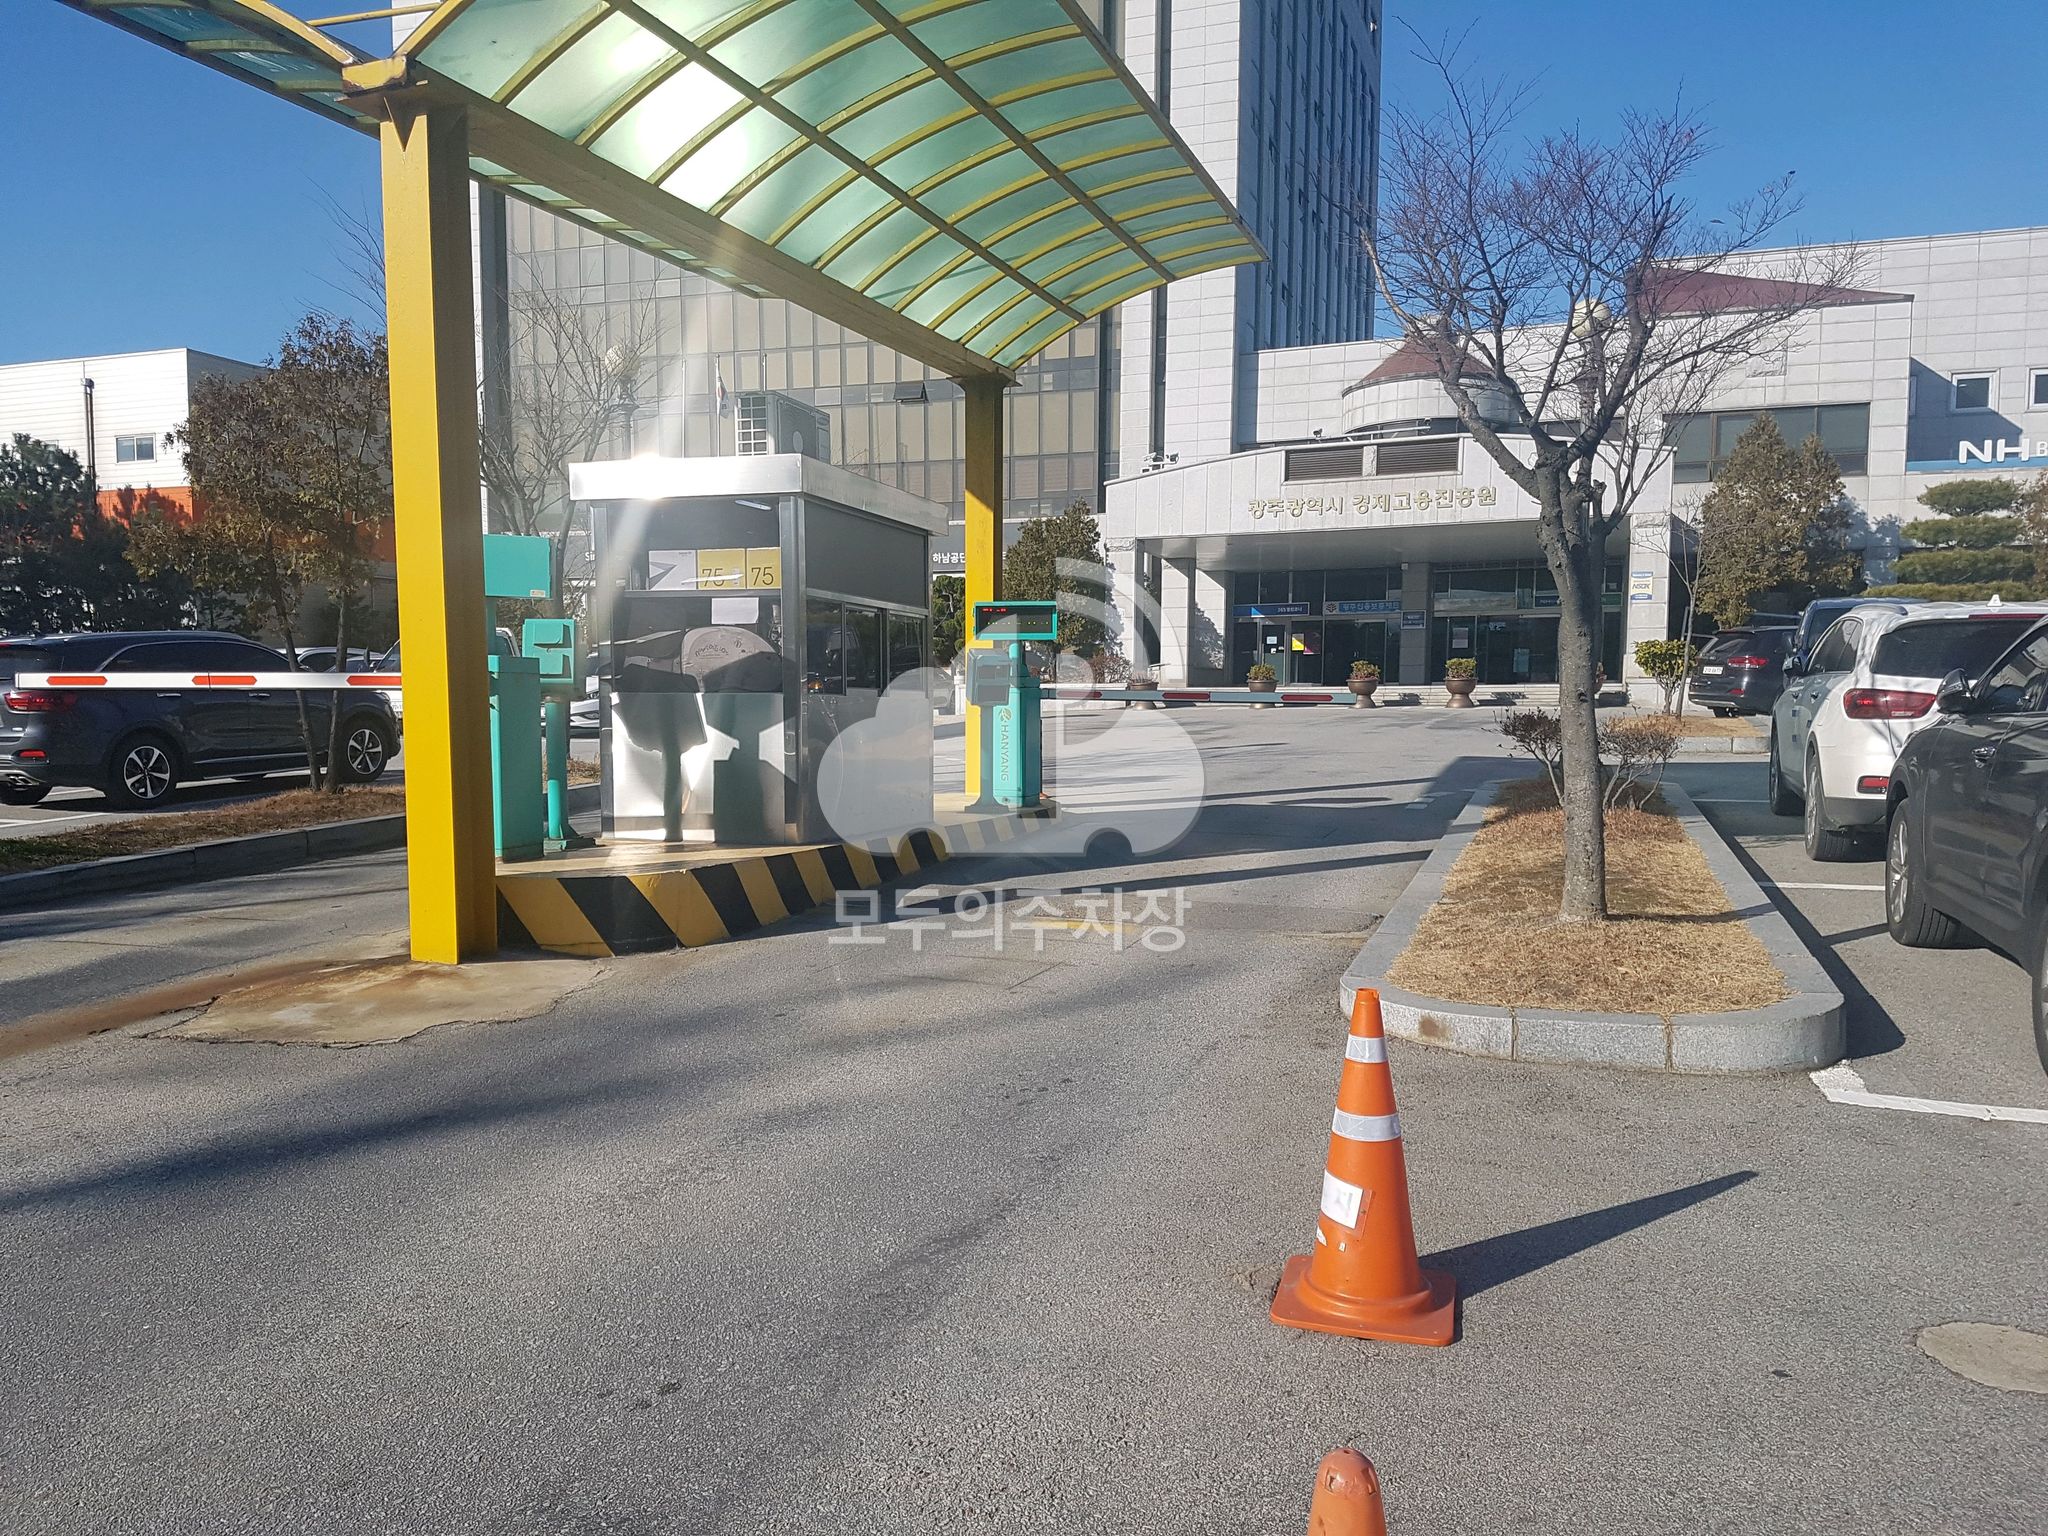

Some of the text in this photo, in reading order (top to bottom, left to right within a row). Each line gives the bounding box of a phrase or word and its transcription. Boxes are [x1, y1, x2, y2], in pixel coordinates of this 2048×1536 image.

[1958, 438, 2030, 464] NH
[1248, 486, 1498, 519] 광주광역시 경제고용진흥원
[751, 566, 774, 586] 75
[1000, 724, 1009, 782] HANYANG
